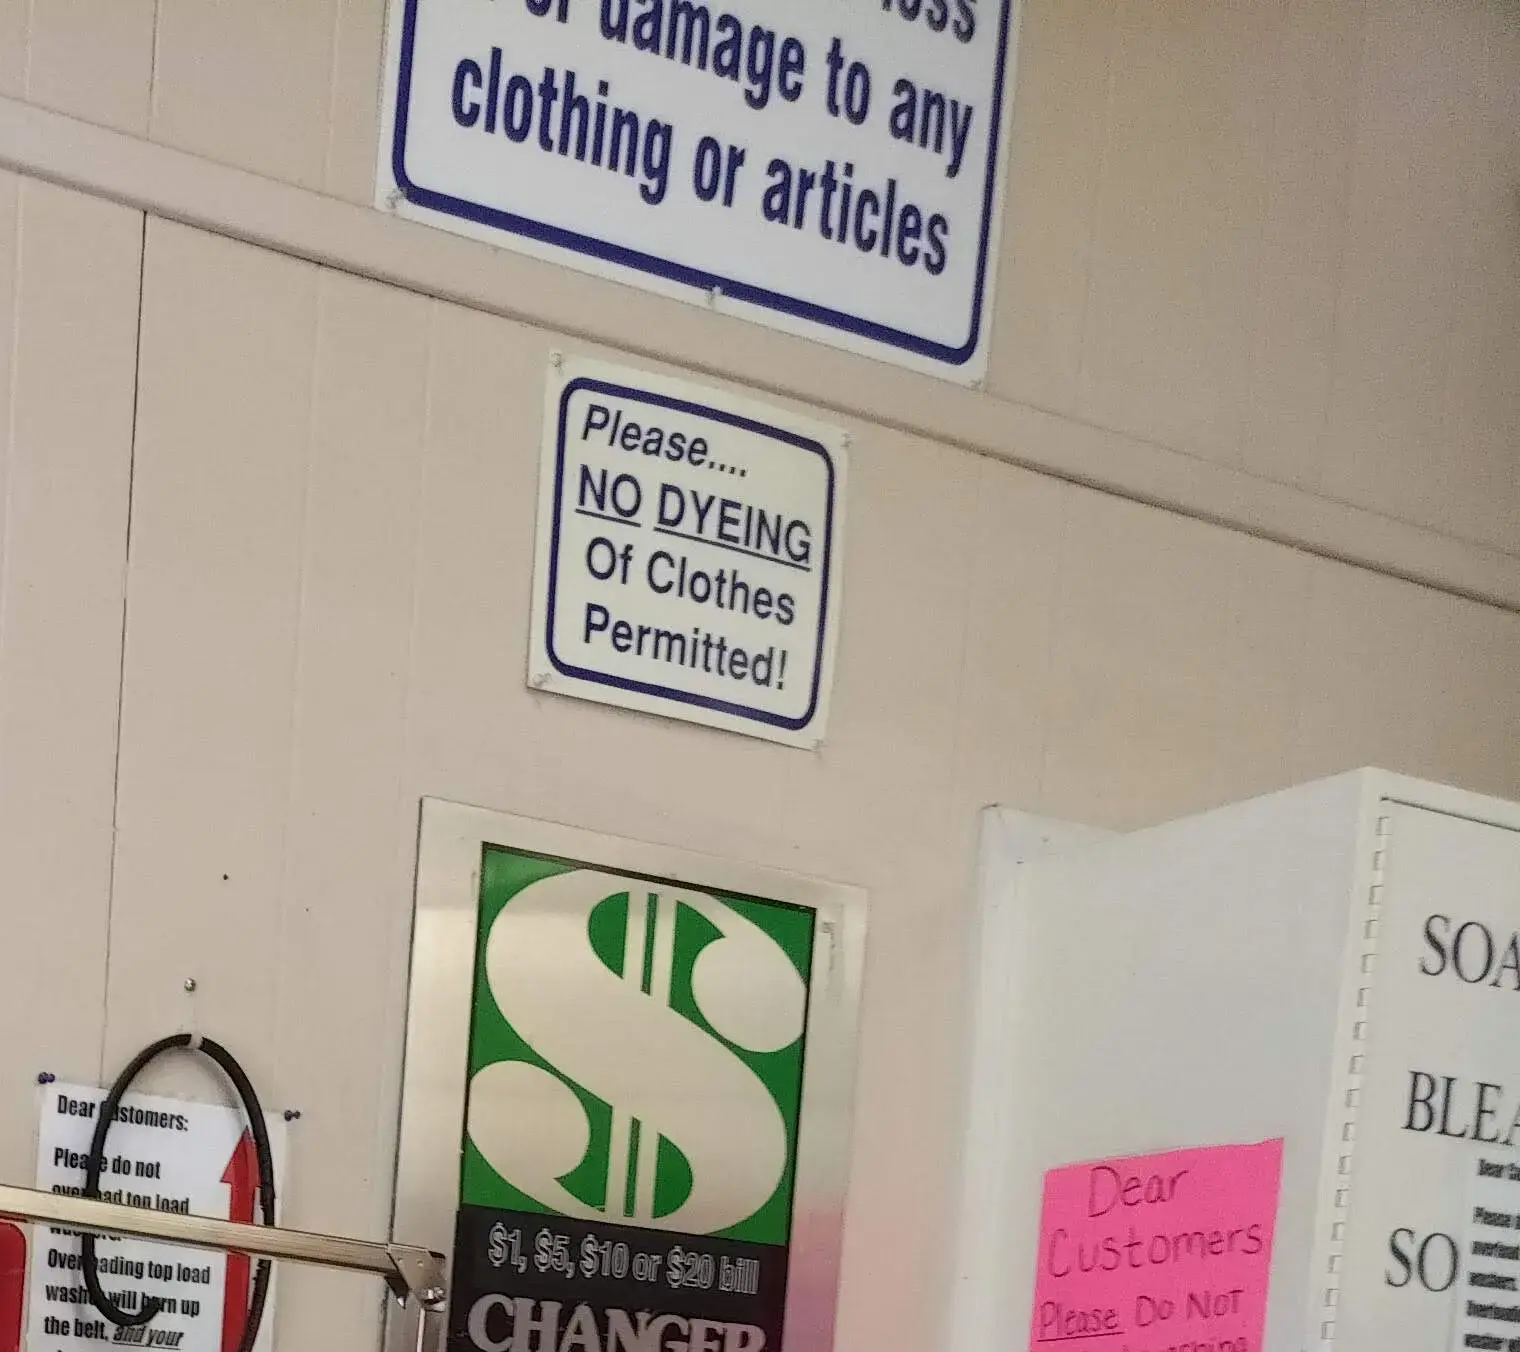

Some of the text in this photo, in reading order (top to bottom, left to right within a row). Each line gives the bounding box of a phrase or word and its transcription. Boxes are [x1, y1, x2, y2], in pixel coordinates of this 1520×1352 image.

[827, 37, 871, 126] to
[890, 78, 973, 178] any
[452, 47, 950, 276] clothing or articles
[578, 464, 811, 564] NO DYEING
[585, 536, 796, 627] Of Clothes
[584, 601, 789, 690] Permitted!
[57, 1095, 95, 1118] Dear
[112, 1155, 161, 1179] do not
[1089, 1165, 1189, 1218] Dear
[148, 1261, 211, 1285] top load
[487, 1221, 761, 1295] $1, $5, $10 or $20 bill
[1048, 1224, 1263, 1278] Customers
[109, 1291, 199, 1318] will up
[1039, 1295, 1176, 1338] Please Do
[45, 1316, 184, 1347] the and your
